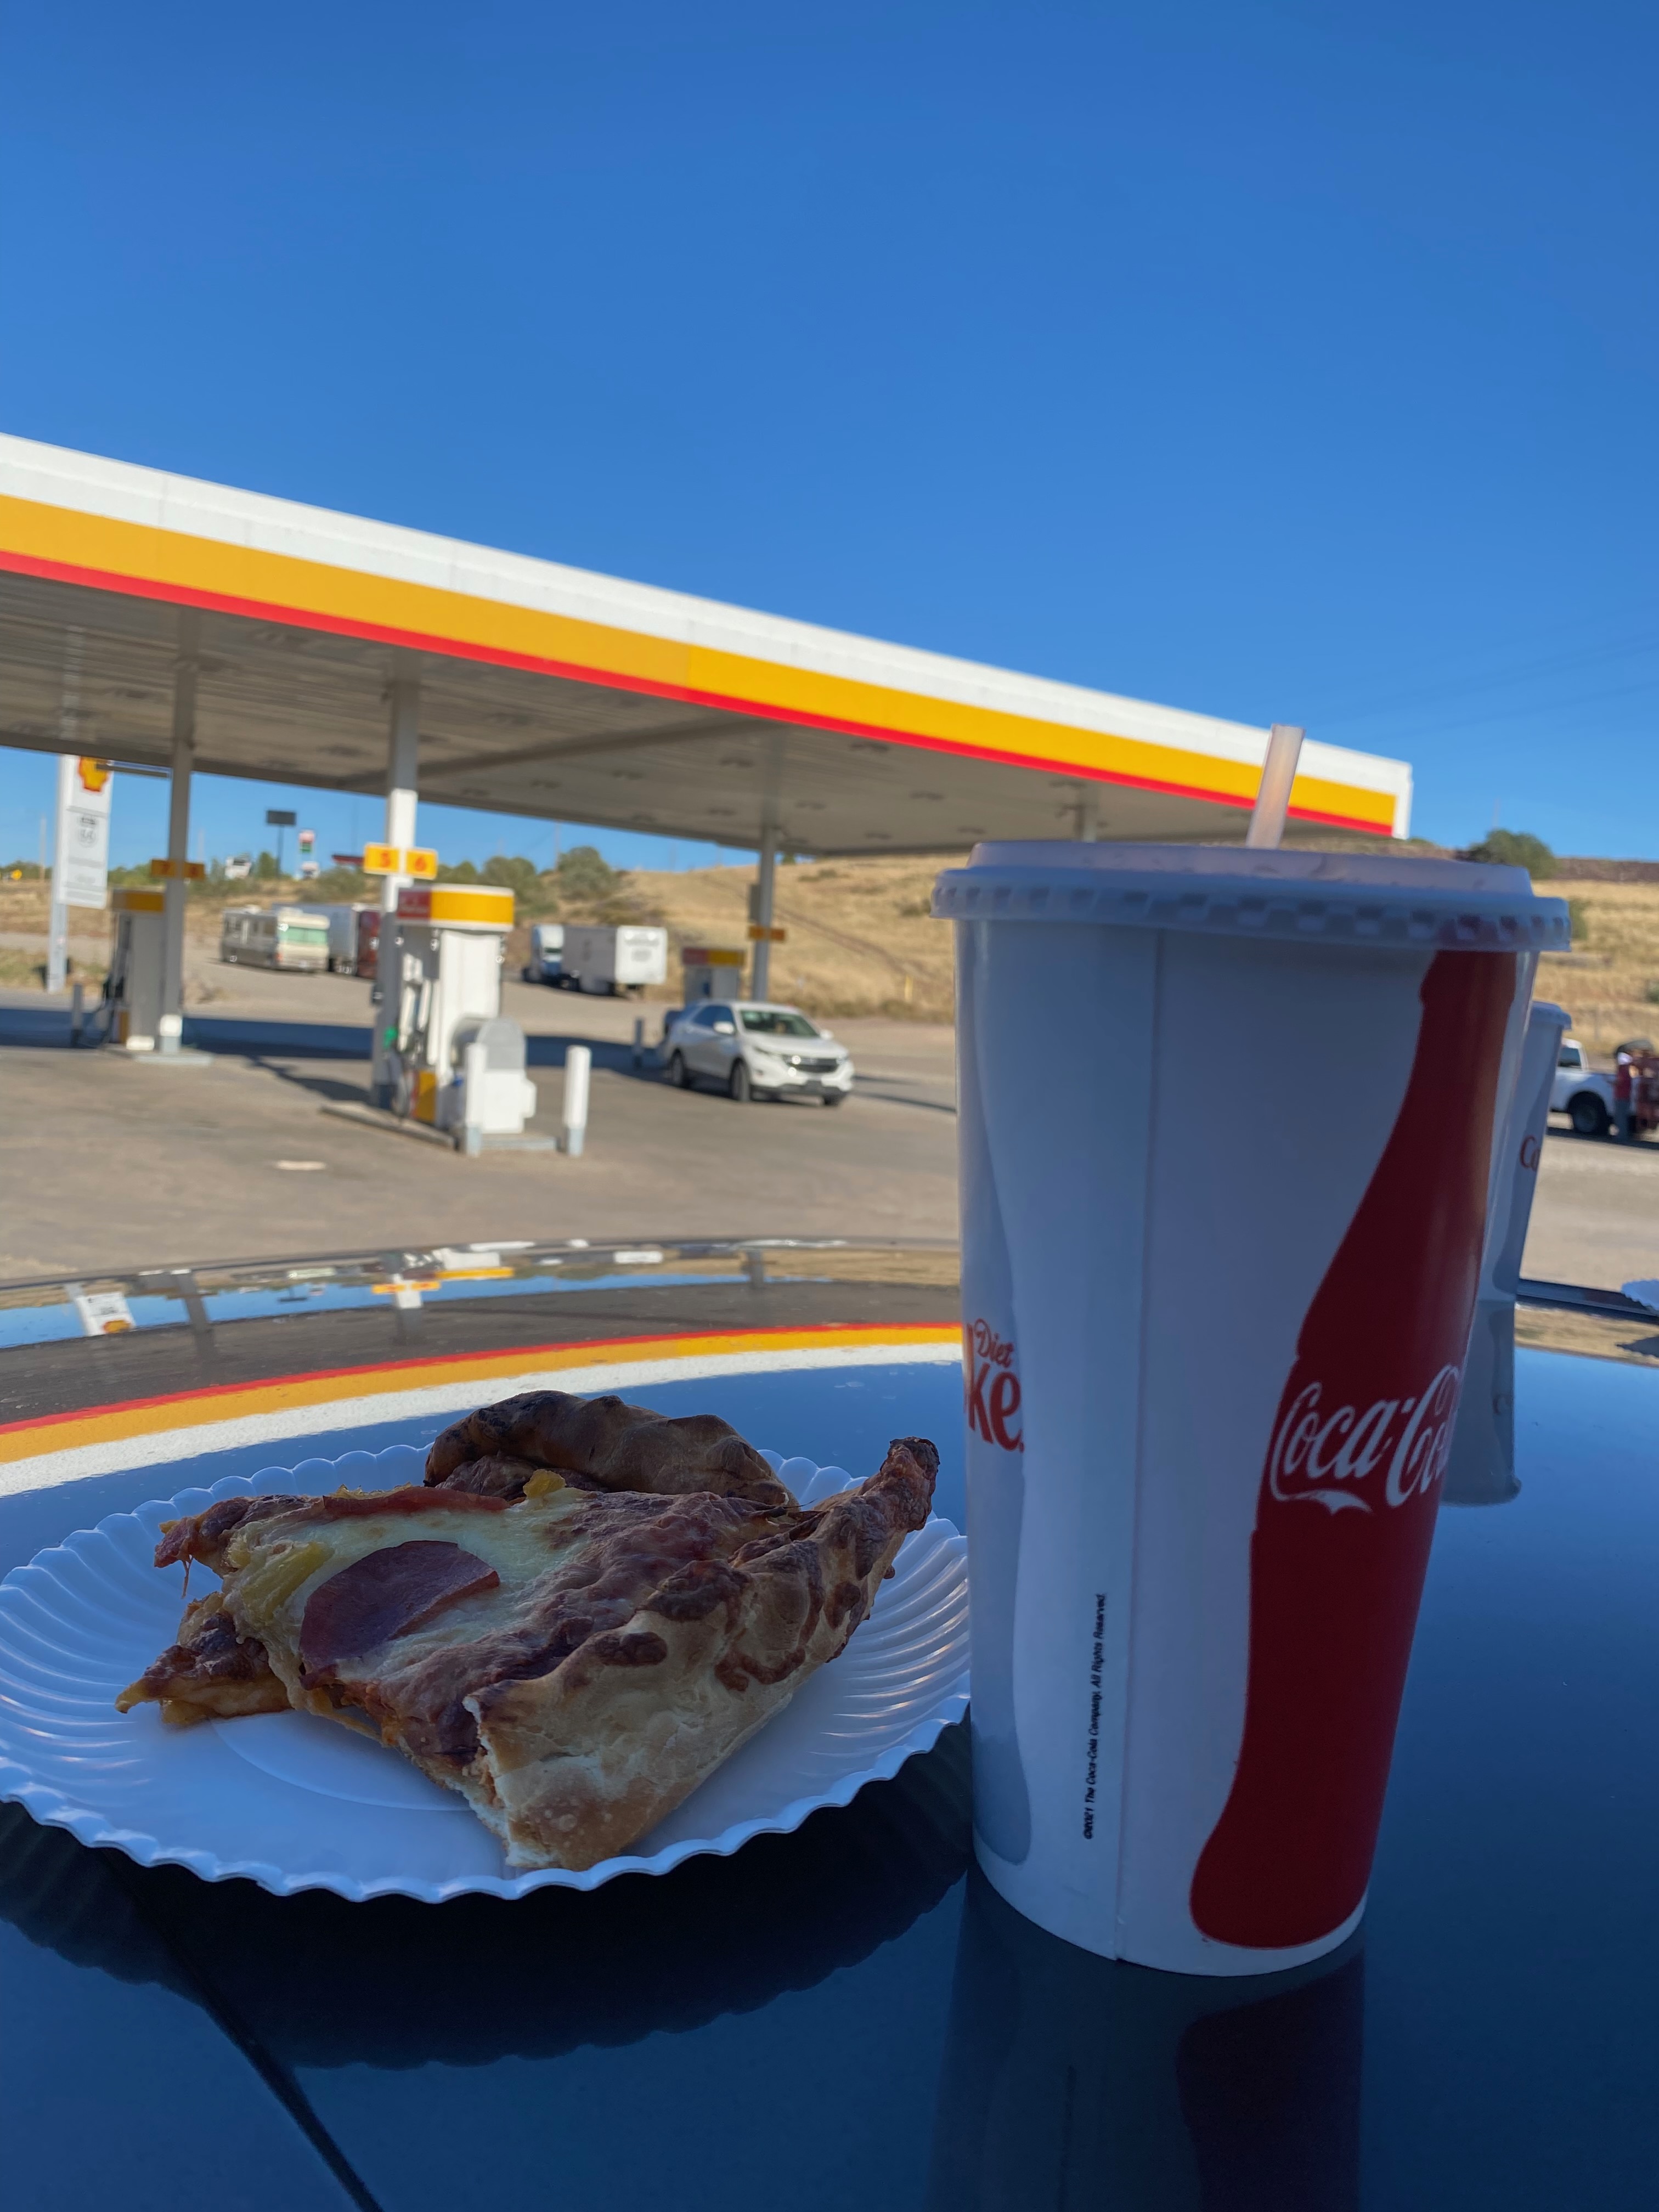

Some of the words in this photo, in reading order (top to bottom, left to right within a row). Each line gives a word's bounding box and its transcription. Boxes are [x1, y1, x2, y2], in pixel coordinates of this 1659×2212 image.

[973, 1318, 1014, 1368] Diet
[964, 1323, 1024, 1453] ke
[1092, 1641, 1105, 1673] Rights
[1090, 1673, 1102, 1689] All
[1086, 1738, 1098, 1785] Coca-Cola
[1084, 1787, 1096, 1803] The
